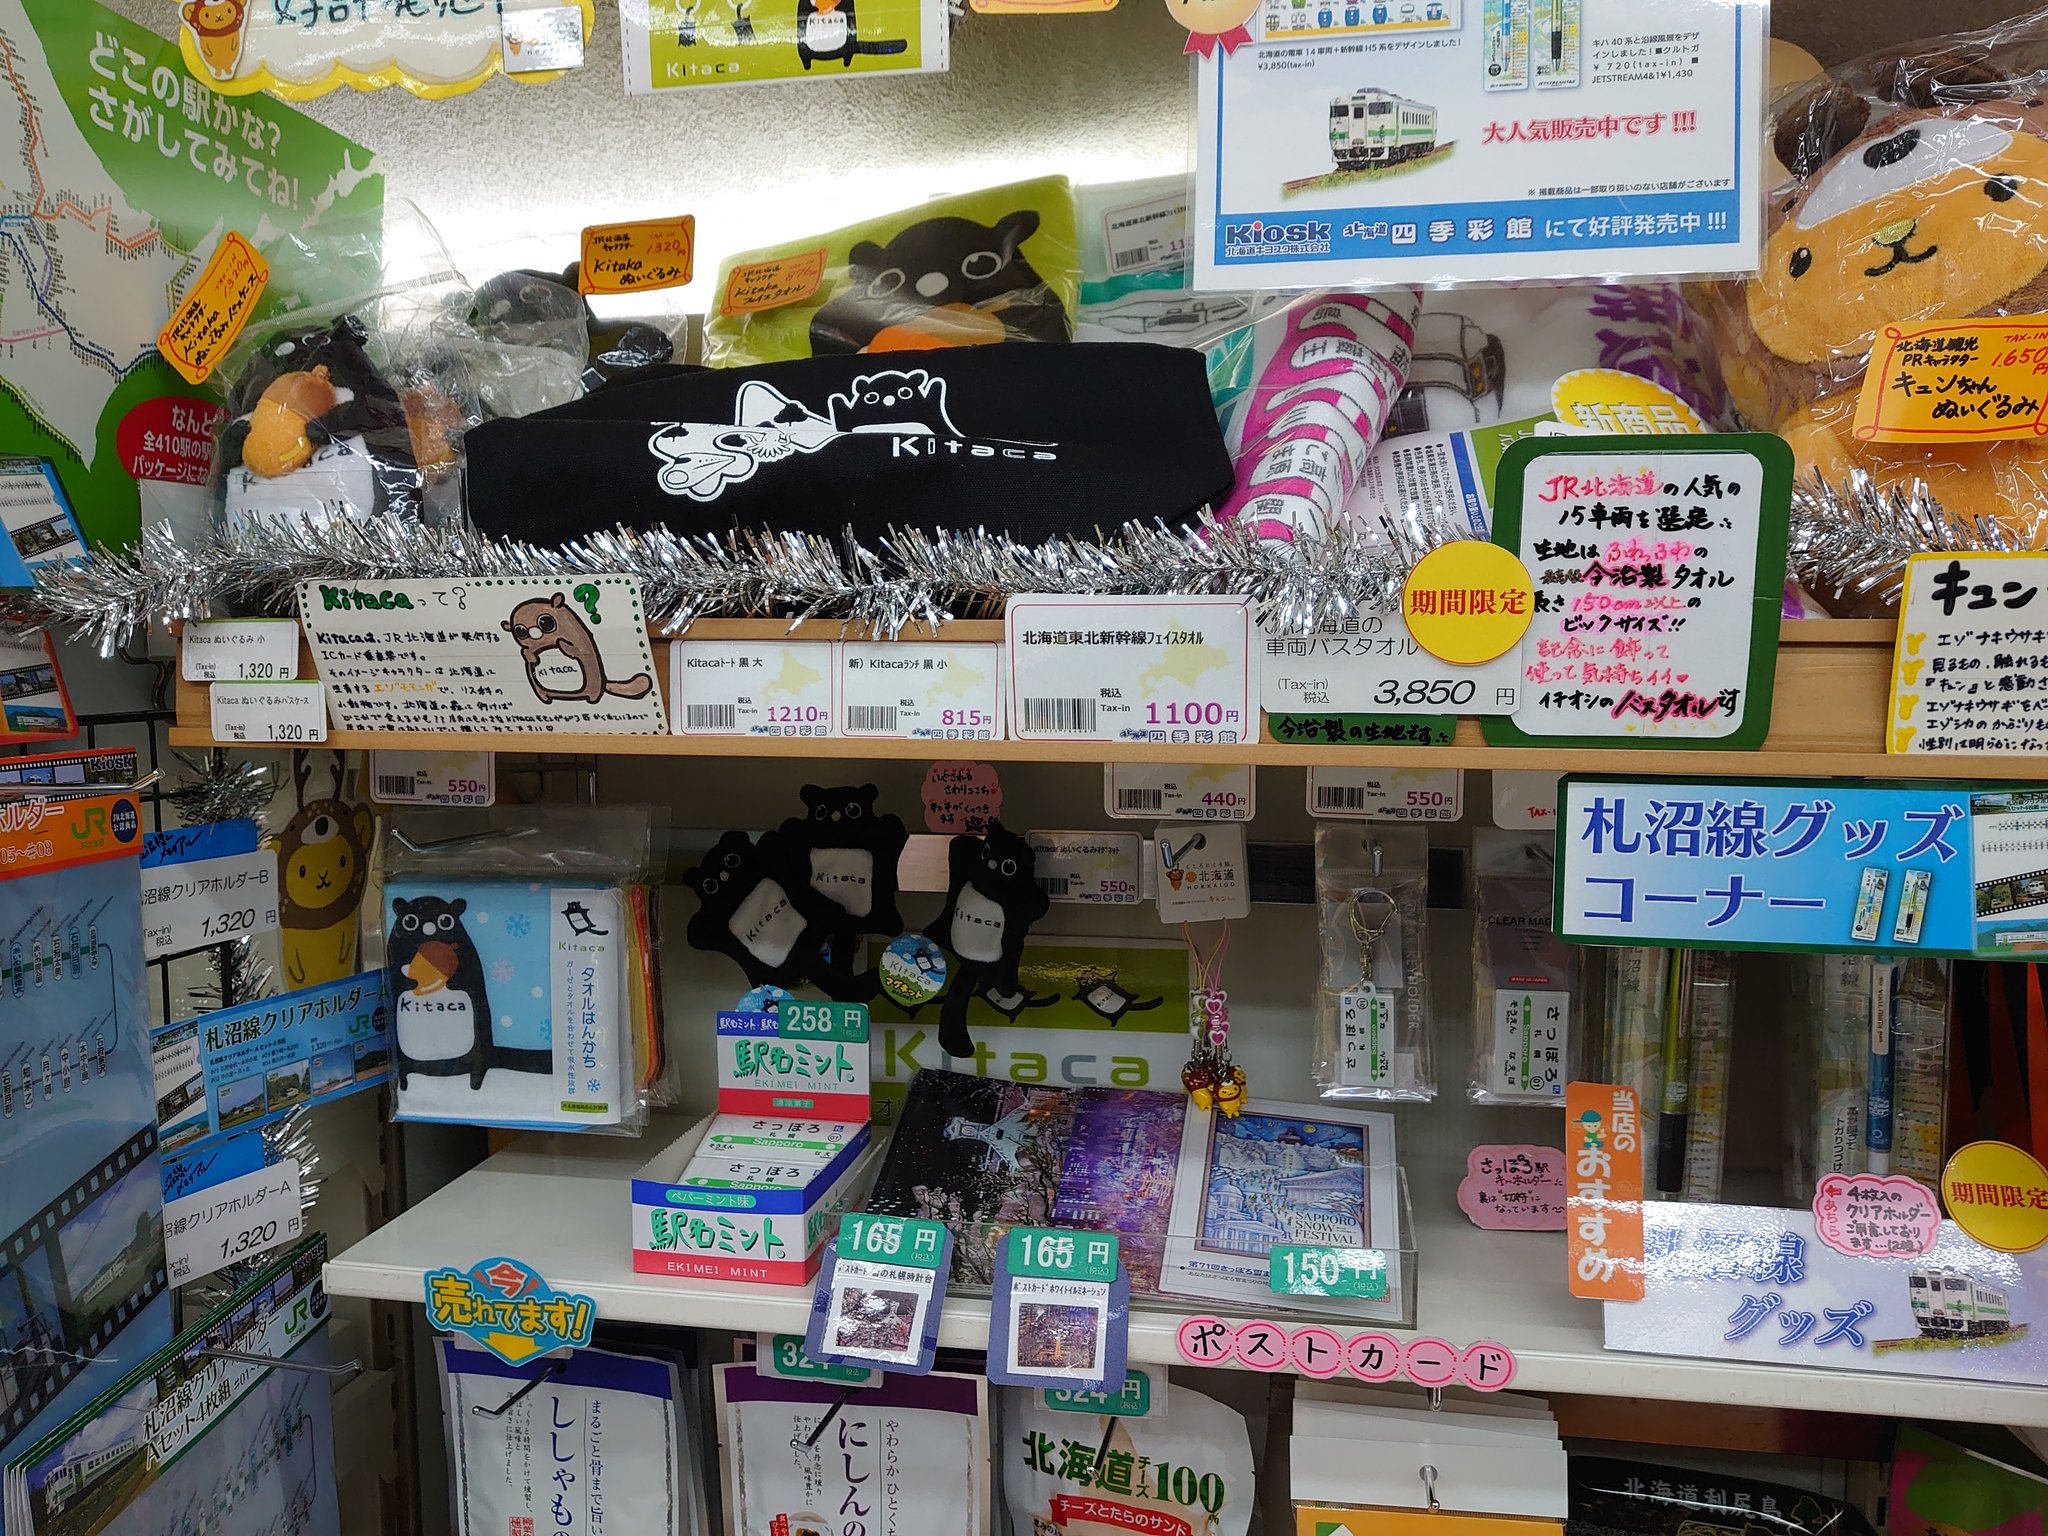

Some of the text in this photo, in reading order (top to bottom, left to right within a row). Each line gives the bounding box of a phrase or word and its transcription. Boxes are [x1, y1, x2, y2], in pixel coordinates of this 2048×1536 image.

[809, 16, 844, 26] Kitaca
[667, 62, 740, 78] Kitaca
[1483, 113, 1665, 145] 大人気販売中です
[1226, 220, 1330, 246] Kiosk
[1226, 242, 1330, 257] 北海道キヨスク株式会社
[593, 258, 643, 274] Kitaka
[619, 266, 682, 285] ぬいぐるみ
[1892, 371, 1998, 398] キュンちゃん
[1570, 400, 1692, 434] 新商品
[1932, 394, 2040, 419] ぬいぐるみ
[892, 436, 1058, 462] Kitaca
[1538, 471, 1741, 502] JR北海道の人気の
[1410, 589, 1528, 615] 期間限定
[1266, 638, 1419, 656] 車両バスタオル
[239, 663, 273, 679] 1,320
[279, 667, 289, 679] 円
[752, 657, 763, 667] 大
[1100, 688, 1122, 698] 税込
[1278, 679, 1515, 705] (Tax-in) 3,850 円
[1303, 692, 1330, 704] 税込
[1100, 704, 1131, 712] Tax-in
[267, 724, 302, 741] 1,320
[308, 729, 319, 740] 円
[71, 807, 107, 839] JR
[1582, 797, 1967, 863] 札沼線グッズ
[815, 872, 867, 885] Kitaca
[1187, 882, 1235, 890] HOKKAIDO
[1199, 869, 1234, 881] 北海道
[1583, 874, 1827, 928] コーナー
[202, 908, 276, 937] 1,320 円
[746, 898, 787, 942] Kitaca
[1488, 916, 1525, 925] CLEAR
[558, 941, 605, 952] Kitaca
[890, 961, 931, 986] Kitaca
[400, 997, 467, 1013] Kitaca
[581, 967, 597, 1069] タオルはんかち
[787, 1006, 861, 1032] 258 円
[1546, 1007, 1560, 1082] さっぽろ
[754, 1079, 839, 1090] EKIMEI MINT
[752, 1120, 821, 1134] さっぽろ
[1612, 1089, 1637, 1152] 当店の
[752, 1137, 804, 1149] Sapporo
[730, 1163, 800, 1178] さっぽろ
[671, 1191, 751, 1208] ペパーミント味
[1951, 1182, 2048, 1210] 期間限定
[1295, 1212, 1357, 1227] SAPPORO
[1295, 1221, 1335, 1232] SNOW
[1576, 1150, 1613, 1284] おすすめ
[1823, 1200, 1842, 1238] あちら
[221, 1220, 277, 1259] 1,320
[852, 1219, 937, 1254] 165 円
[1295, 1231, 1357, 1244] FESTIVAL
[1021, 1234, 1110, 1269] 165 円
[486, 1262, 528, 1297] 今
[667, 1261, 768, 1278] EKIMEI MINT
[1283, 1252, 1338, 1287] 150
[285, 1297, 307, 1335] JR
[432, 1274, 589, 1340] 売れてます!
[1724, 1292, 1875, 1348] グッズ
[1191, 1323, 1503, 1381] ポストカード
[1121, 1379, 1140, 1399] 円
[1022, 1431, 1135, 1498] 北海道
[1136, 1456, 1151, 1499] チーズ
[1623, 1477, 1783, 1524] 北海道利尻島
[1059, 1499, 1188, 1536] チーズとたらのサンド
